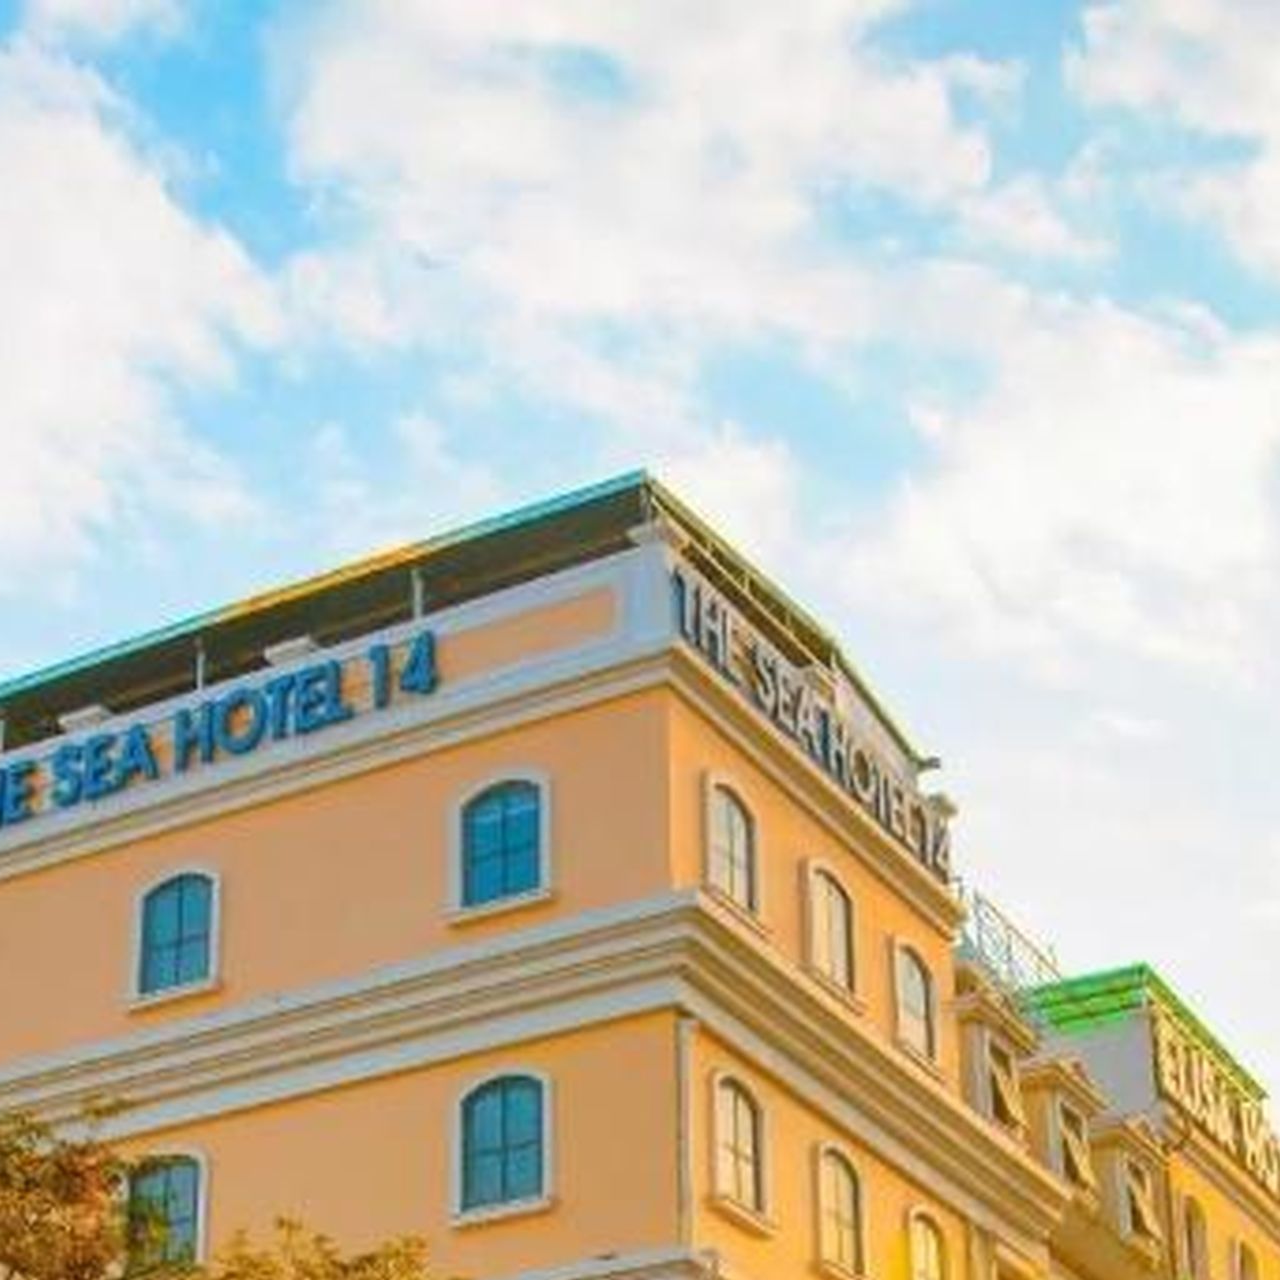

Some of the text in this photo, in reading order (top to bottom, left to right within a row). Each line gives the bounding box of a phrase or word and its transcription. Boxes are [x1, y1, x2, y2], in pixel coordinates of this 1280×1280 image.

[52, 732, 161, 808] SEA
[173, 658, 353, 774] HOTEL
[367, 629, 441, 710] 14
[673, 565, 744, 690] THE
[749, 638, 826, 766] SEA
[822, 708, 922, 858] HOTEL
